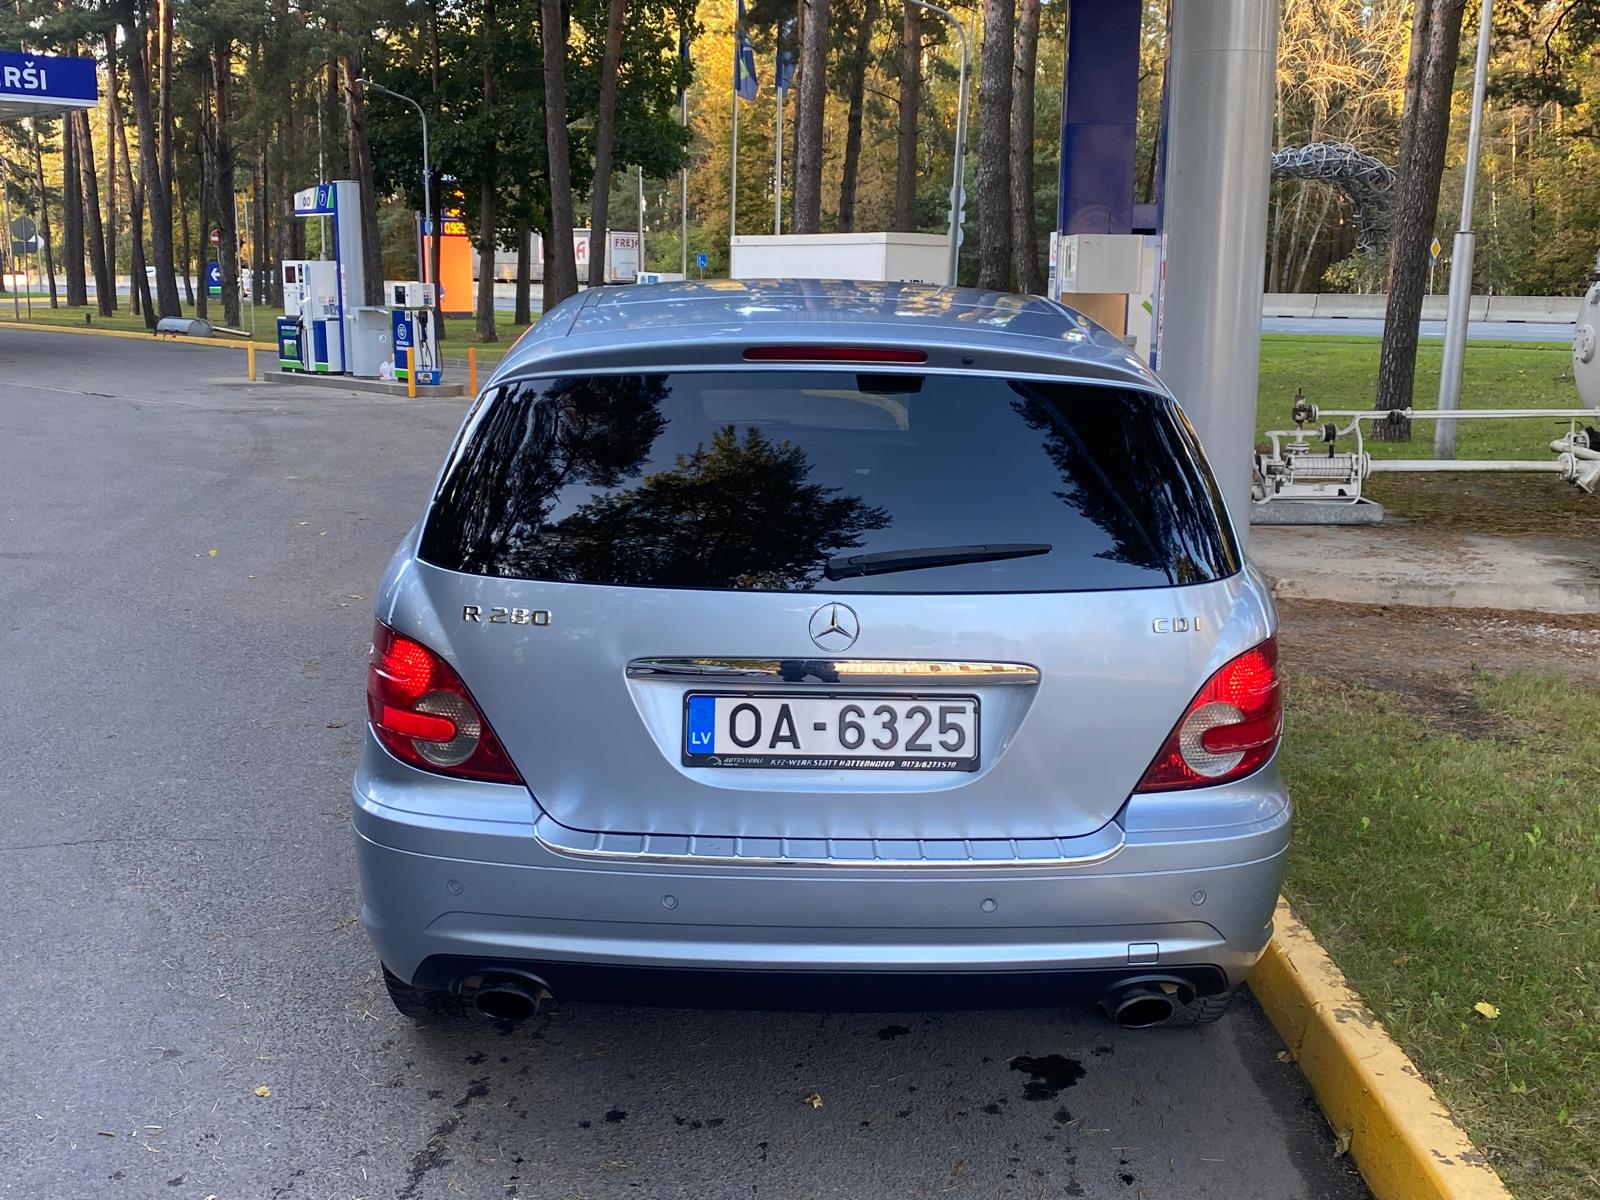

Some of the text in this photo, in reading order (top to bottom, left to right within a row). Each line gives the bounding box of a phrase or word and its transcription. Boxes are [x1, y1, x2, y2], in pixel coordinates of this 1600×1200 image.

[0, 61, 47, 90] RŠI
[463, 604, 552, 626] R 280
[1152, 616, 1201, 633] CDI
[692, 731, 712, 745] LV
[729, 702, 967, 753] OA-6325
